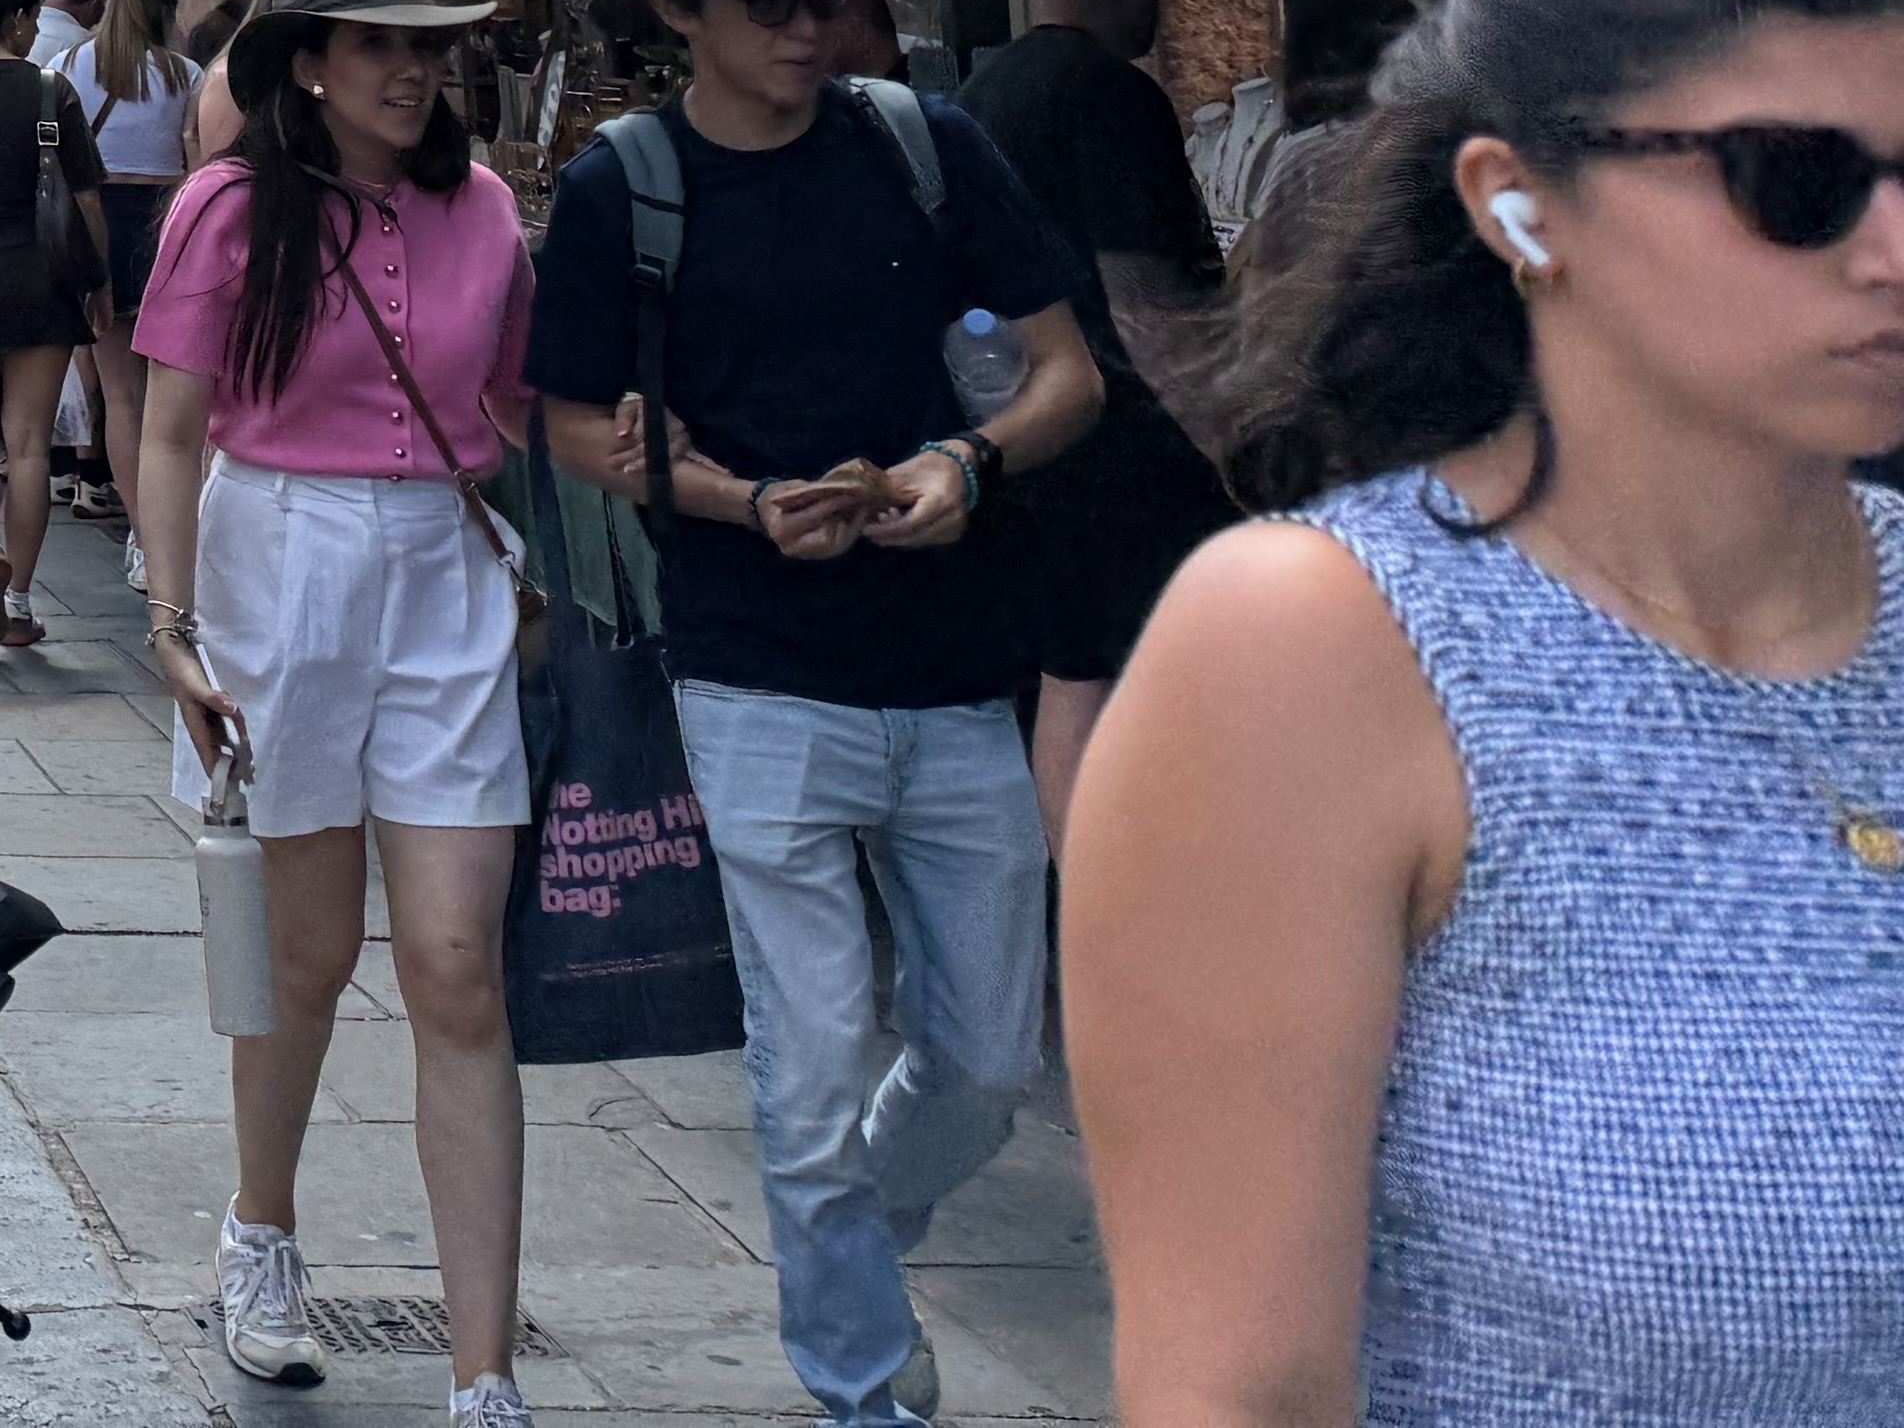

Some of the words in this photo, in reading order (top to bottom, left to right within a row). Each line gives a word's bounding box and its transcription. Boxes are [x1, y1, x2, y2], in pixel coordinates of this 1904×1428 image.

[549, 781, 592, 809] he
[542, 809, 658, 846] Notting
[660, 794, 706, 831] Hi
[540, 836, 701, 882] shopping
